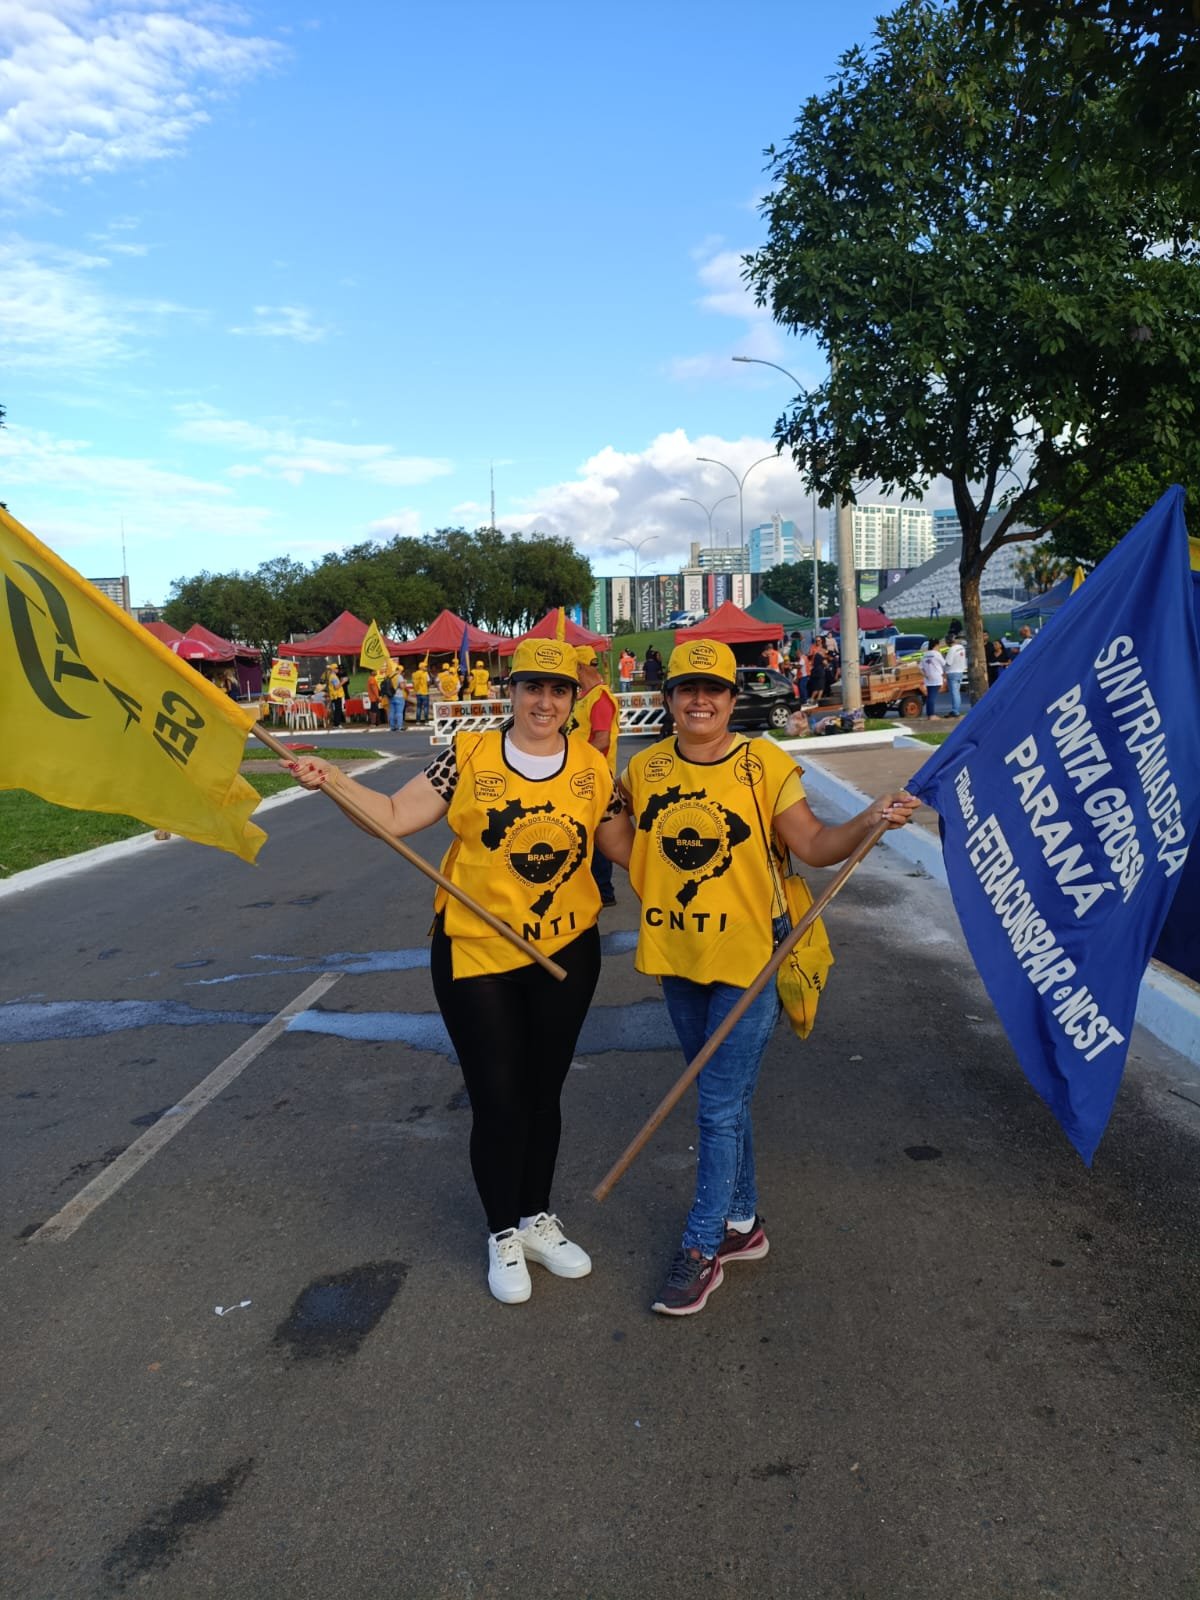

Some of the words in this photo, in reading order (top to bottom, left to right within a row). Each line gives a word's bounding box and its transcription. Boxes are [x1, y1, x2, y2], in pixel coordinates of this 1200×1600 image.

[665, 580, 674, 598] RIO
[690, 589, 701, 610] BRB
[1046, 683, 1113, 795] PONTA
[966, 814, 979, 832] a
[1004, 734, 1116, 919] PARANÁ
[676, 839, 704, 847] BRASIL
[527, 852, 555, 862] BRASIL
[965, 812, 1077, 996] FETRACONSPAR
[504, 911, 576, 941] NTI
[645, 907, 727, 933] CNTI
[1052, 985, 1073, 1001] e
[1052, 985, 1126, 1062] NCST
